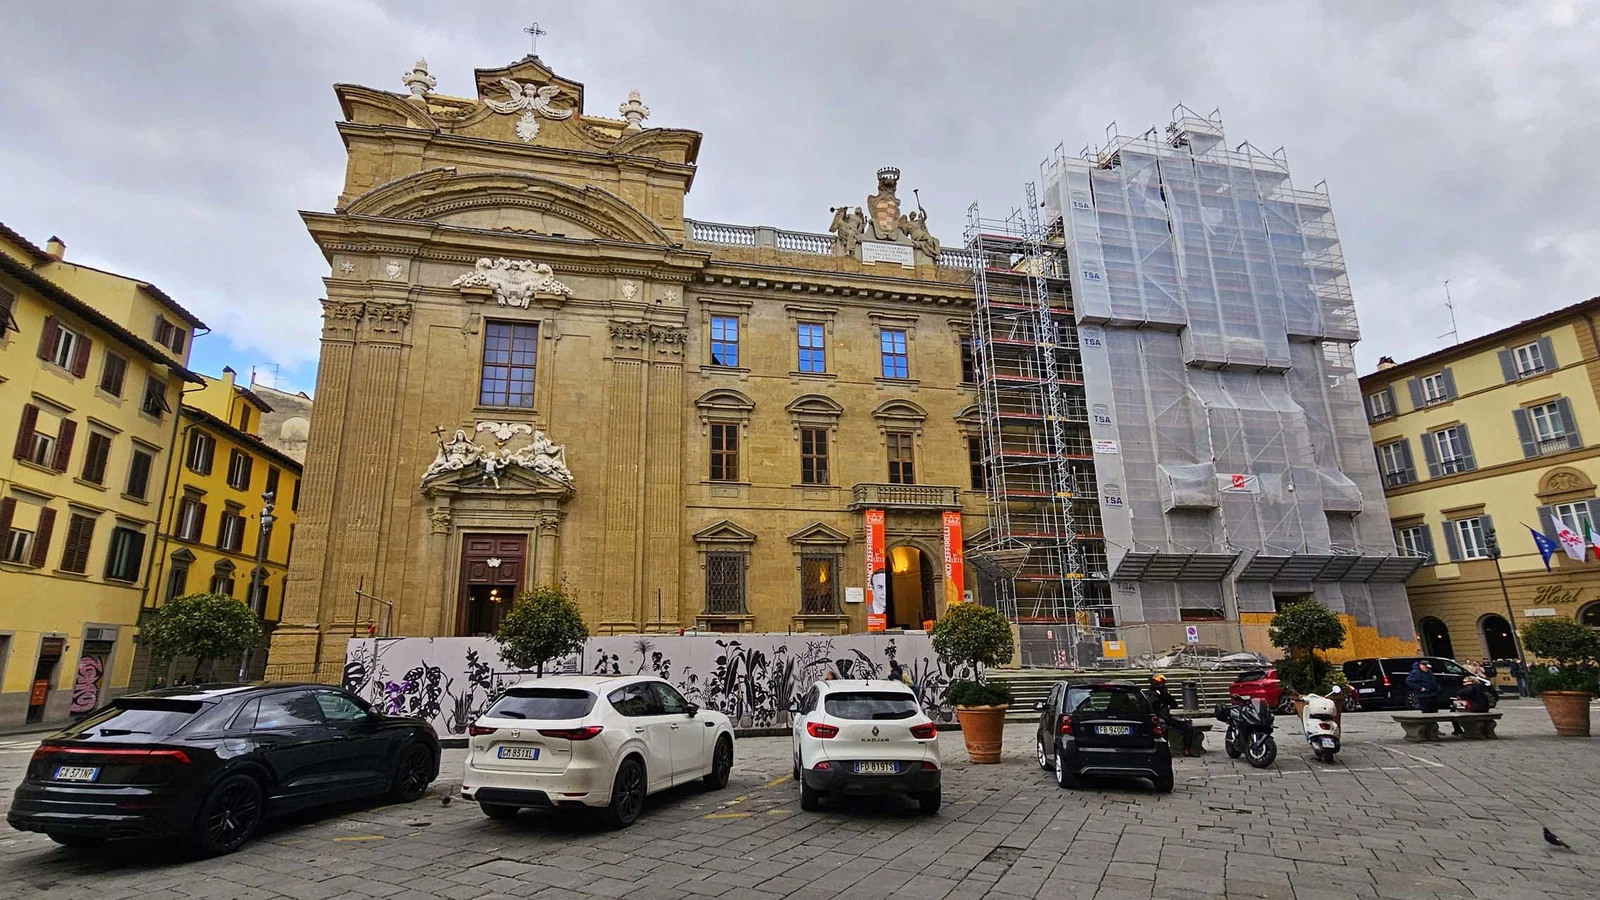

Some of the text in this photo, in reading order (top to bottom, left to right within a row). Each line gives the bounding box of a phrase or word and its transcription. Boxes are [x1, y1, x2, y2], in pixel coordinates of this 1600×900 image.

[1073, 201, 1090, 210] TSA
[1083, 270, 1101, 280] TSA
[1084, 338, 1101, 347] TSA
[1093, 414, 1112, 424] TSA
[1104, 496, 1123, 505] TSA
[943, 526, 951, 563] ZEFFIRELLI
[1533, 584, 1584, 604] Hotel
[860, 762, 894, 771] FD 819TS
